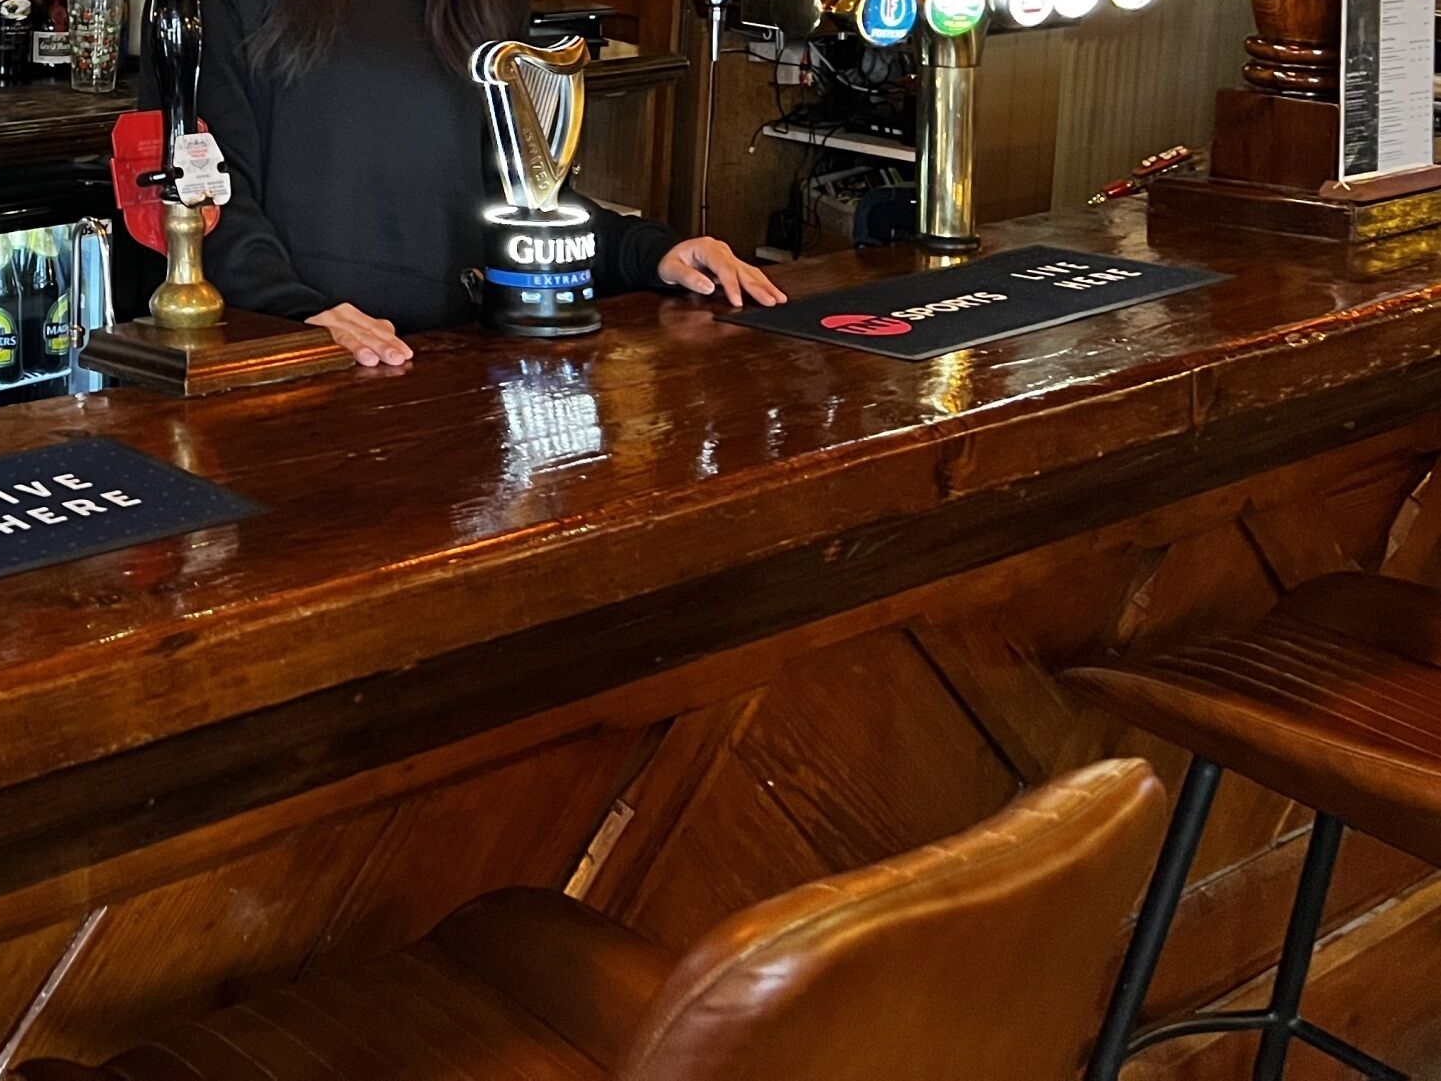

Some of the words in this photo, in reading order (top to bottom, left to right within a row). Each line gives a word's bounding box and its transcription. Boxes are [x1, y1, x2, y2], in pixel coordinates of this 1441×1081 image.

[533, 273, 578, 286] EXTRA
[1010, 261, 1090, 282] LIVE
[1054, 267, 1143, 291] HERE
[835, 316, 900, 336] TNT
[891, 290, 1008, 321] SPORTS
